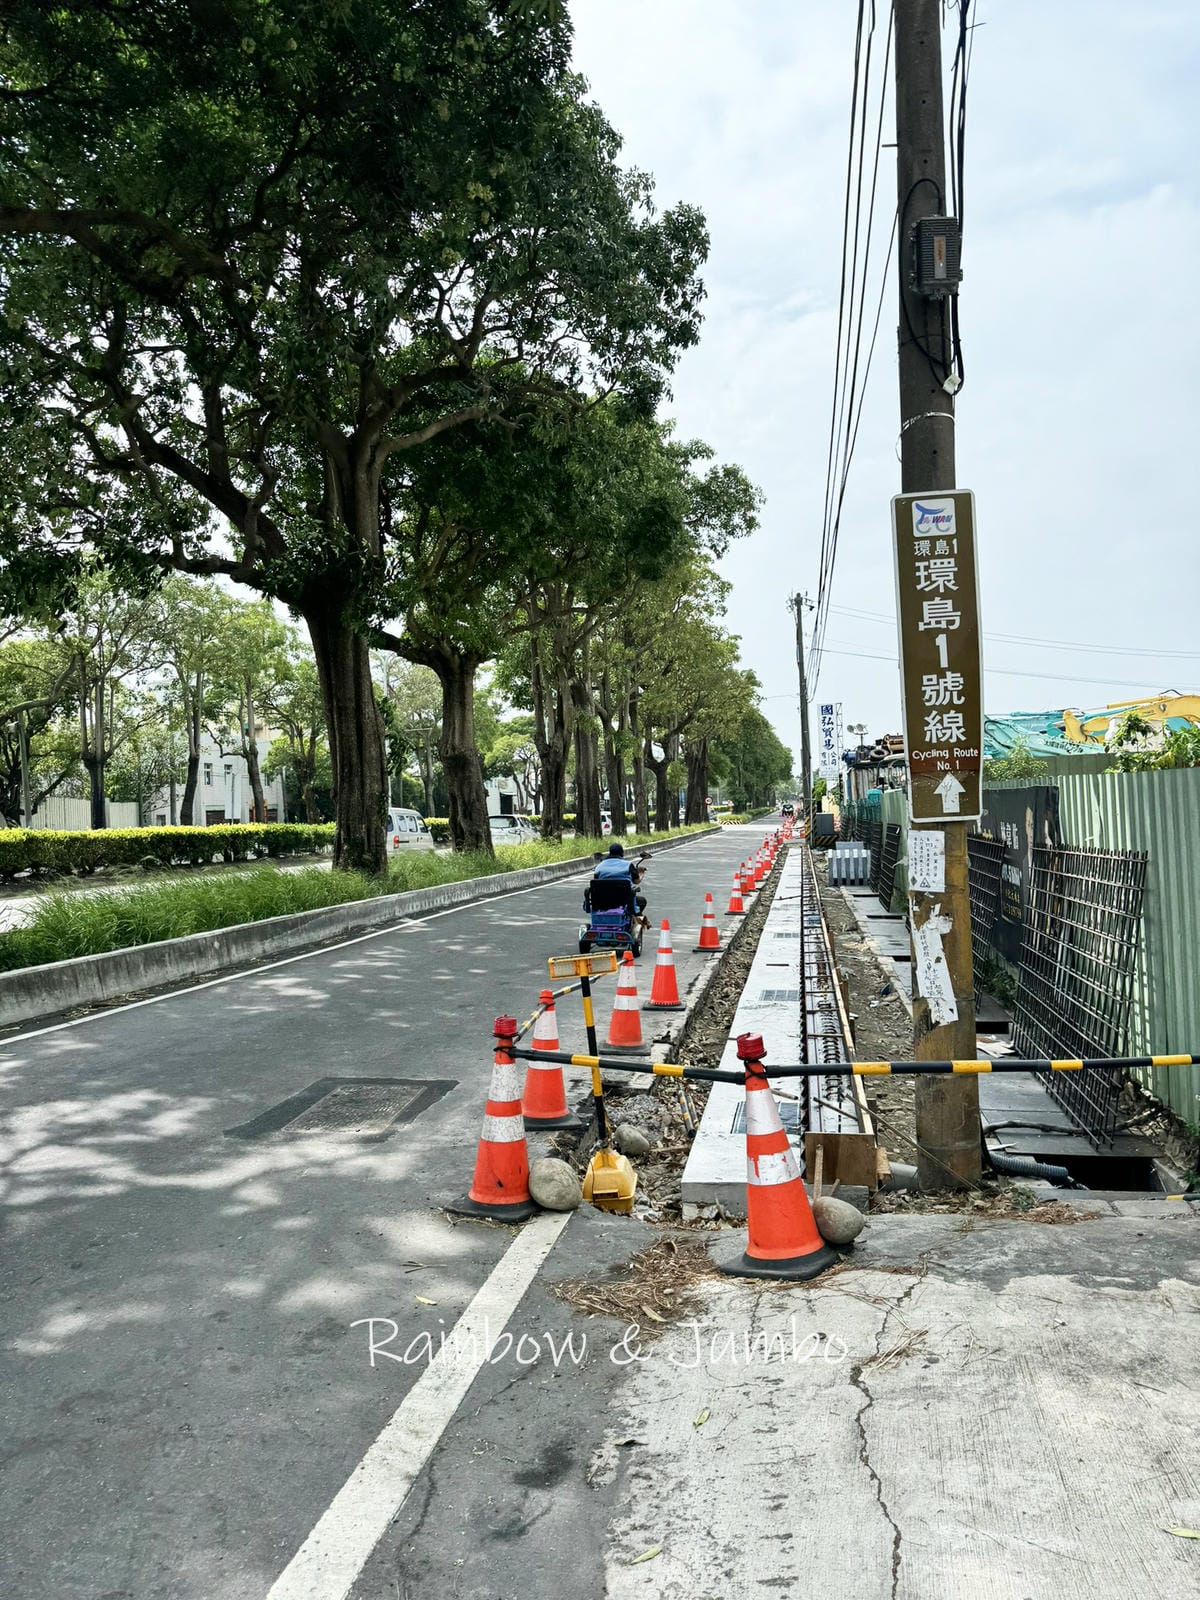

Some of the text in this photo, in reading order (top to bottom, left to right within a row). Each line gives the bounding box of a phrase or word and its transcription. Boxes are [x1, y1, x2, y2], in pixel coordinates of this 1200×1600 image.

[913, 538, 958, 557] 環島1
[915, 557, 967, 744] 環島1號線
[912, 748, 979, 760] Cycling Route
[936, 760, 960, 771] No. 1
